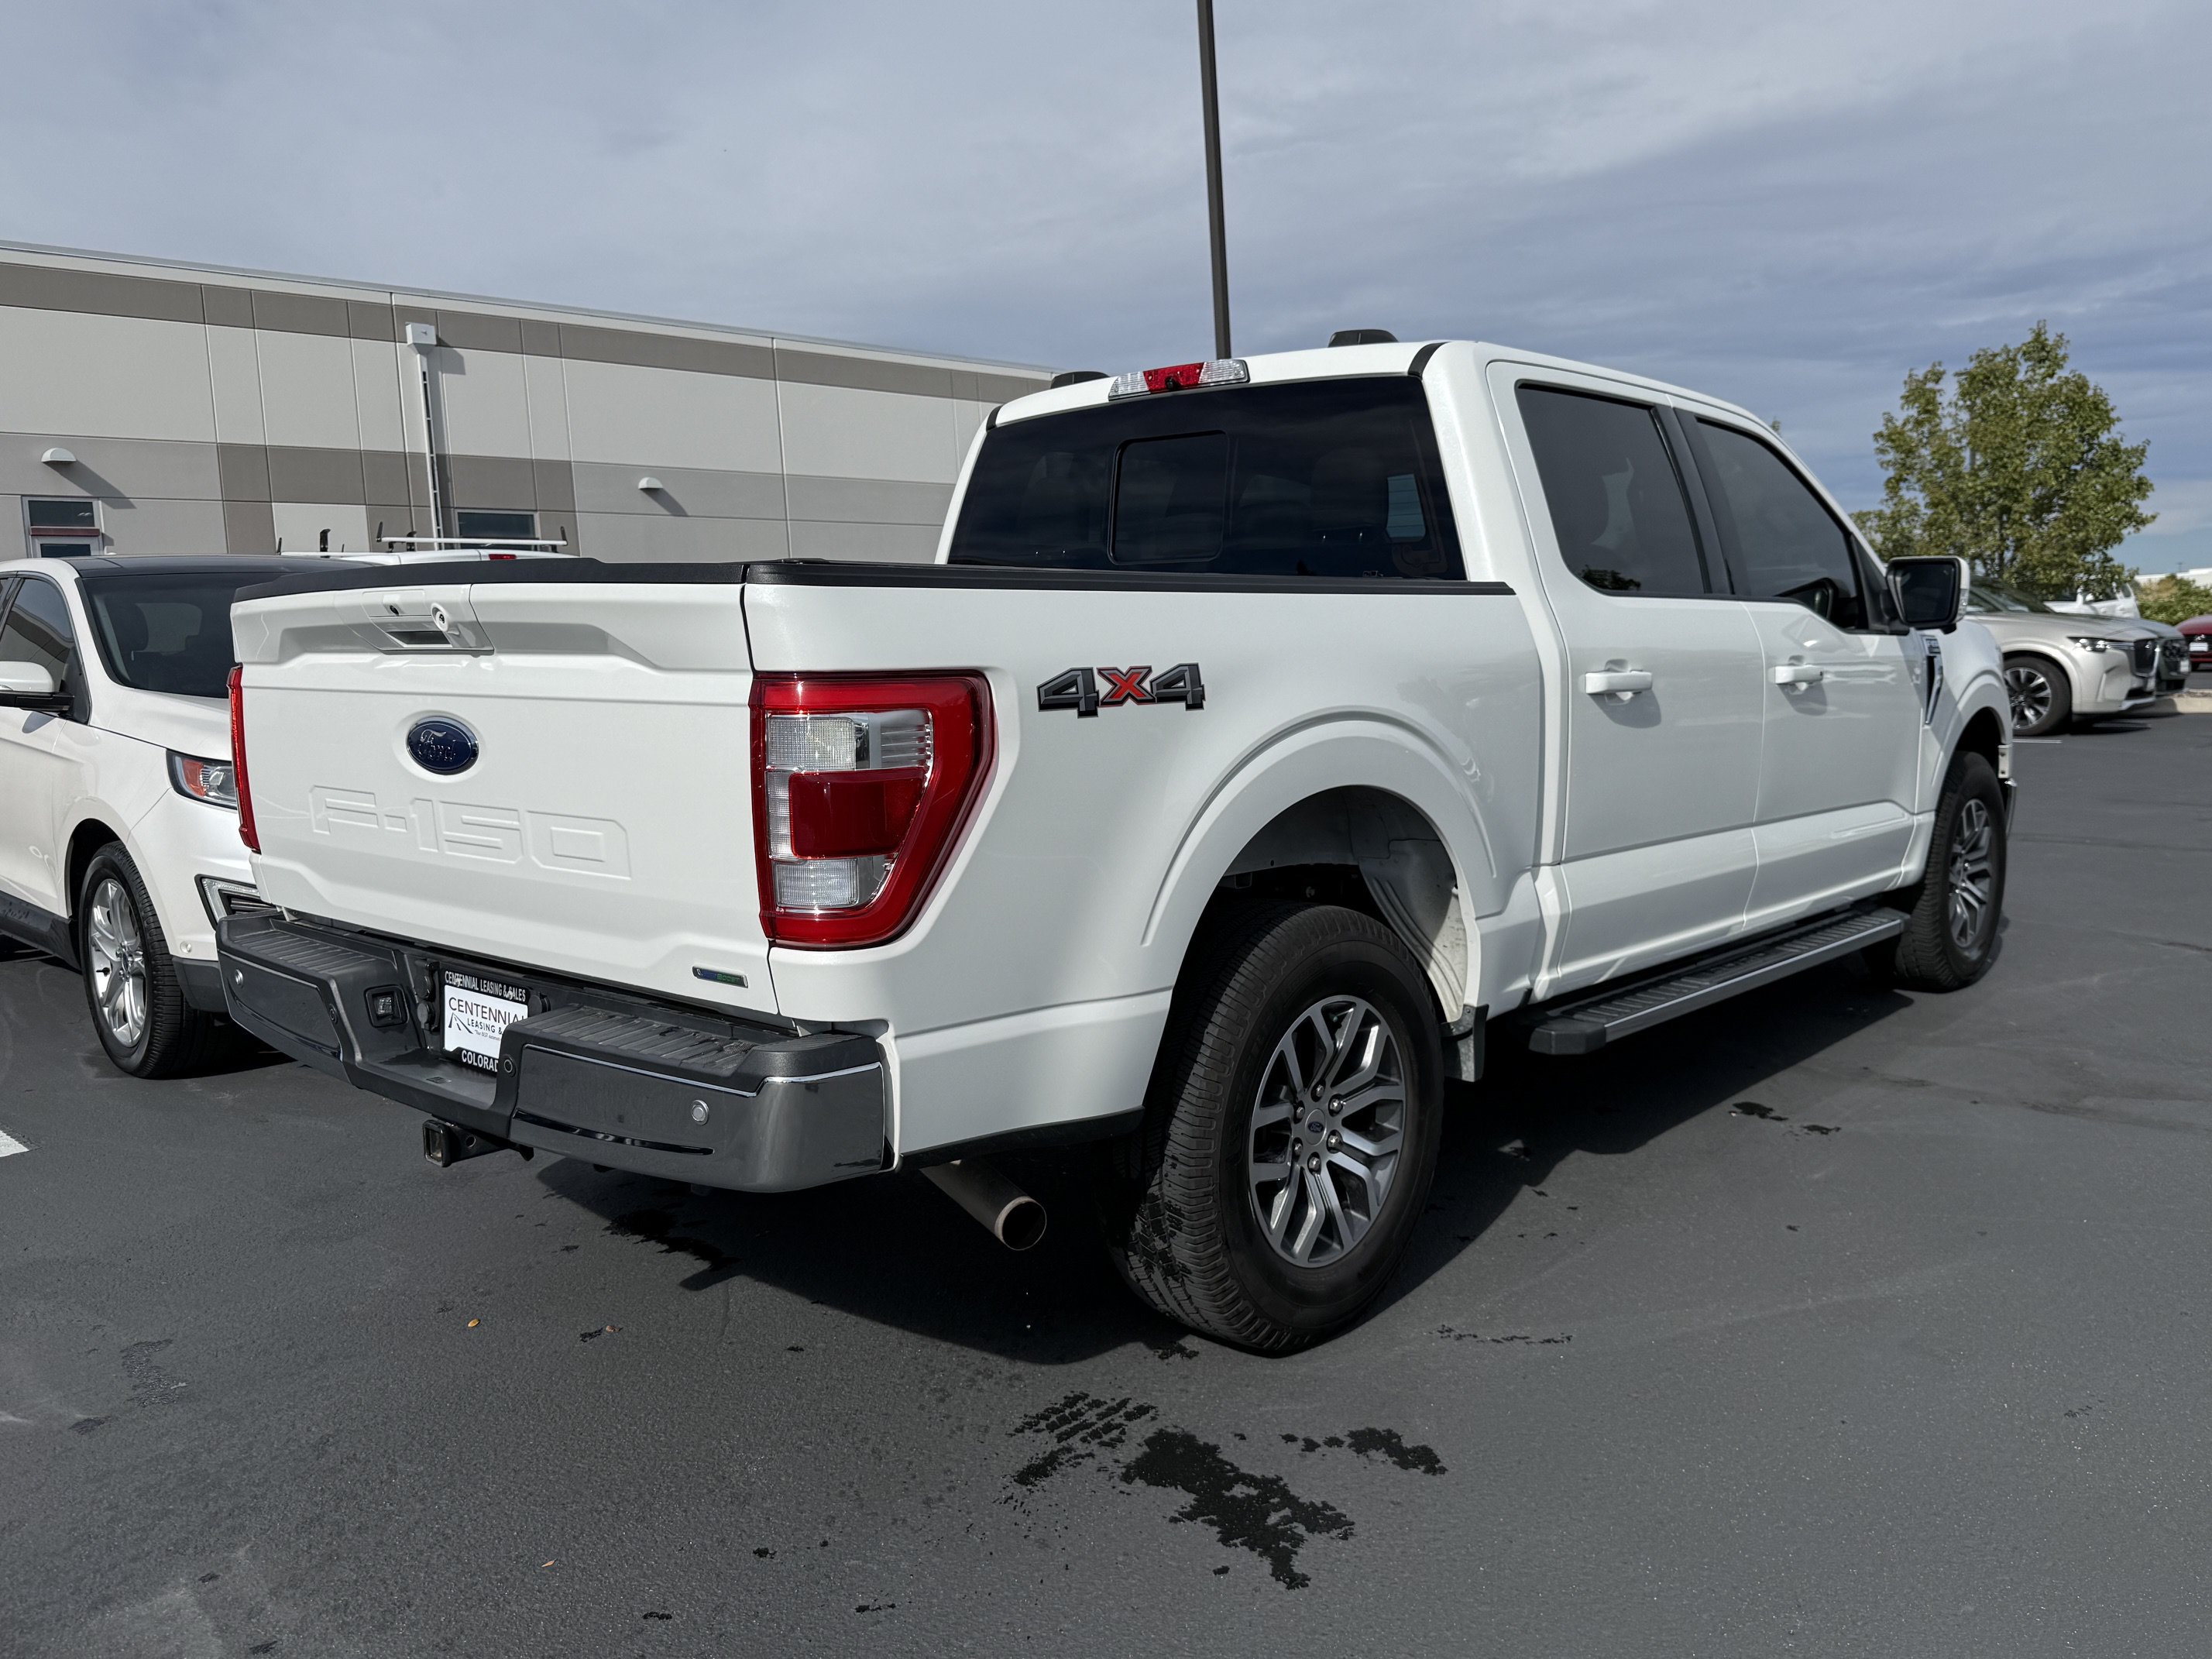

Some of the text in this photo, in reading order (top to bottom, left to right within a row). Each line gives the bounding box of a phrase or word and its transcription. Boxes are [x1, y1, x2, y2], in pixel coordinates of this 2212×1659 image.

[419, 729, 456, 761] Ford
[309, 785, 631, 880] F-150
[445, 970, 479, 991] CENTENNIAL
[480, 979, 502, 996] LEASING
[448, 997, 524, 1025] CENTENNIA
[467, 1018, 503, 1035] LEASING &
[462, 1049, 499, 1072] COLORAD
